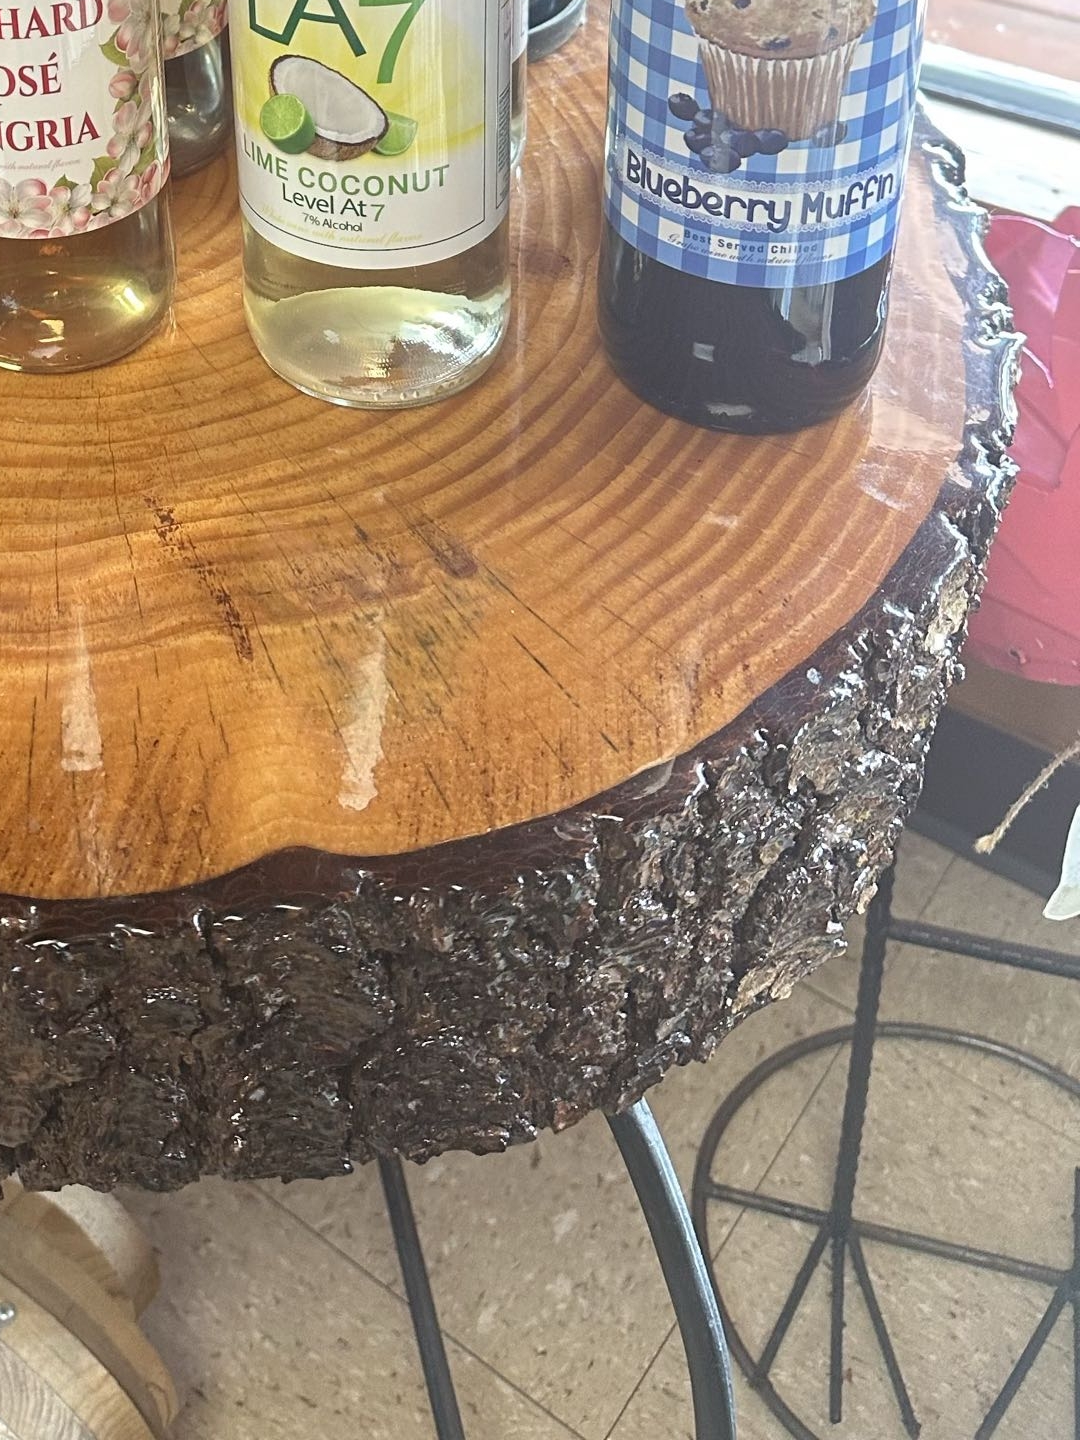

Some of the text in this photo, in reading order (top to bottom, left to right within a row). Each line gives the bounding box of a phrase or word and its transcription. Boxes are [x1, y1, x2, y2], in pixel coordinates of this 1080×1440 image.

[244, 133, 450, 196] LIME COCONUT
[282, 182, 334, 215] Level
[340, 198, 367, 218] At
[370, 204, 386, 222] 7
[626, 148, 894, 233] Blueberry Muffin
[301, 212, 320, 226] 7%
[322, 218, 363, 233] Alcohol
[684, 229, 818, 254] Best Served Chilled
